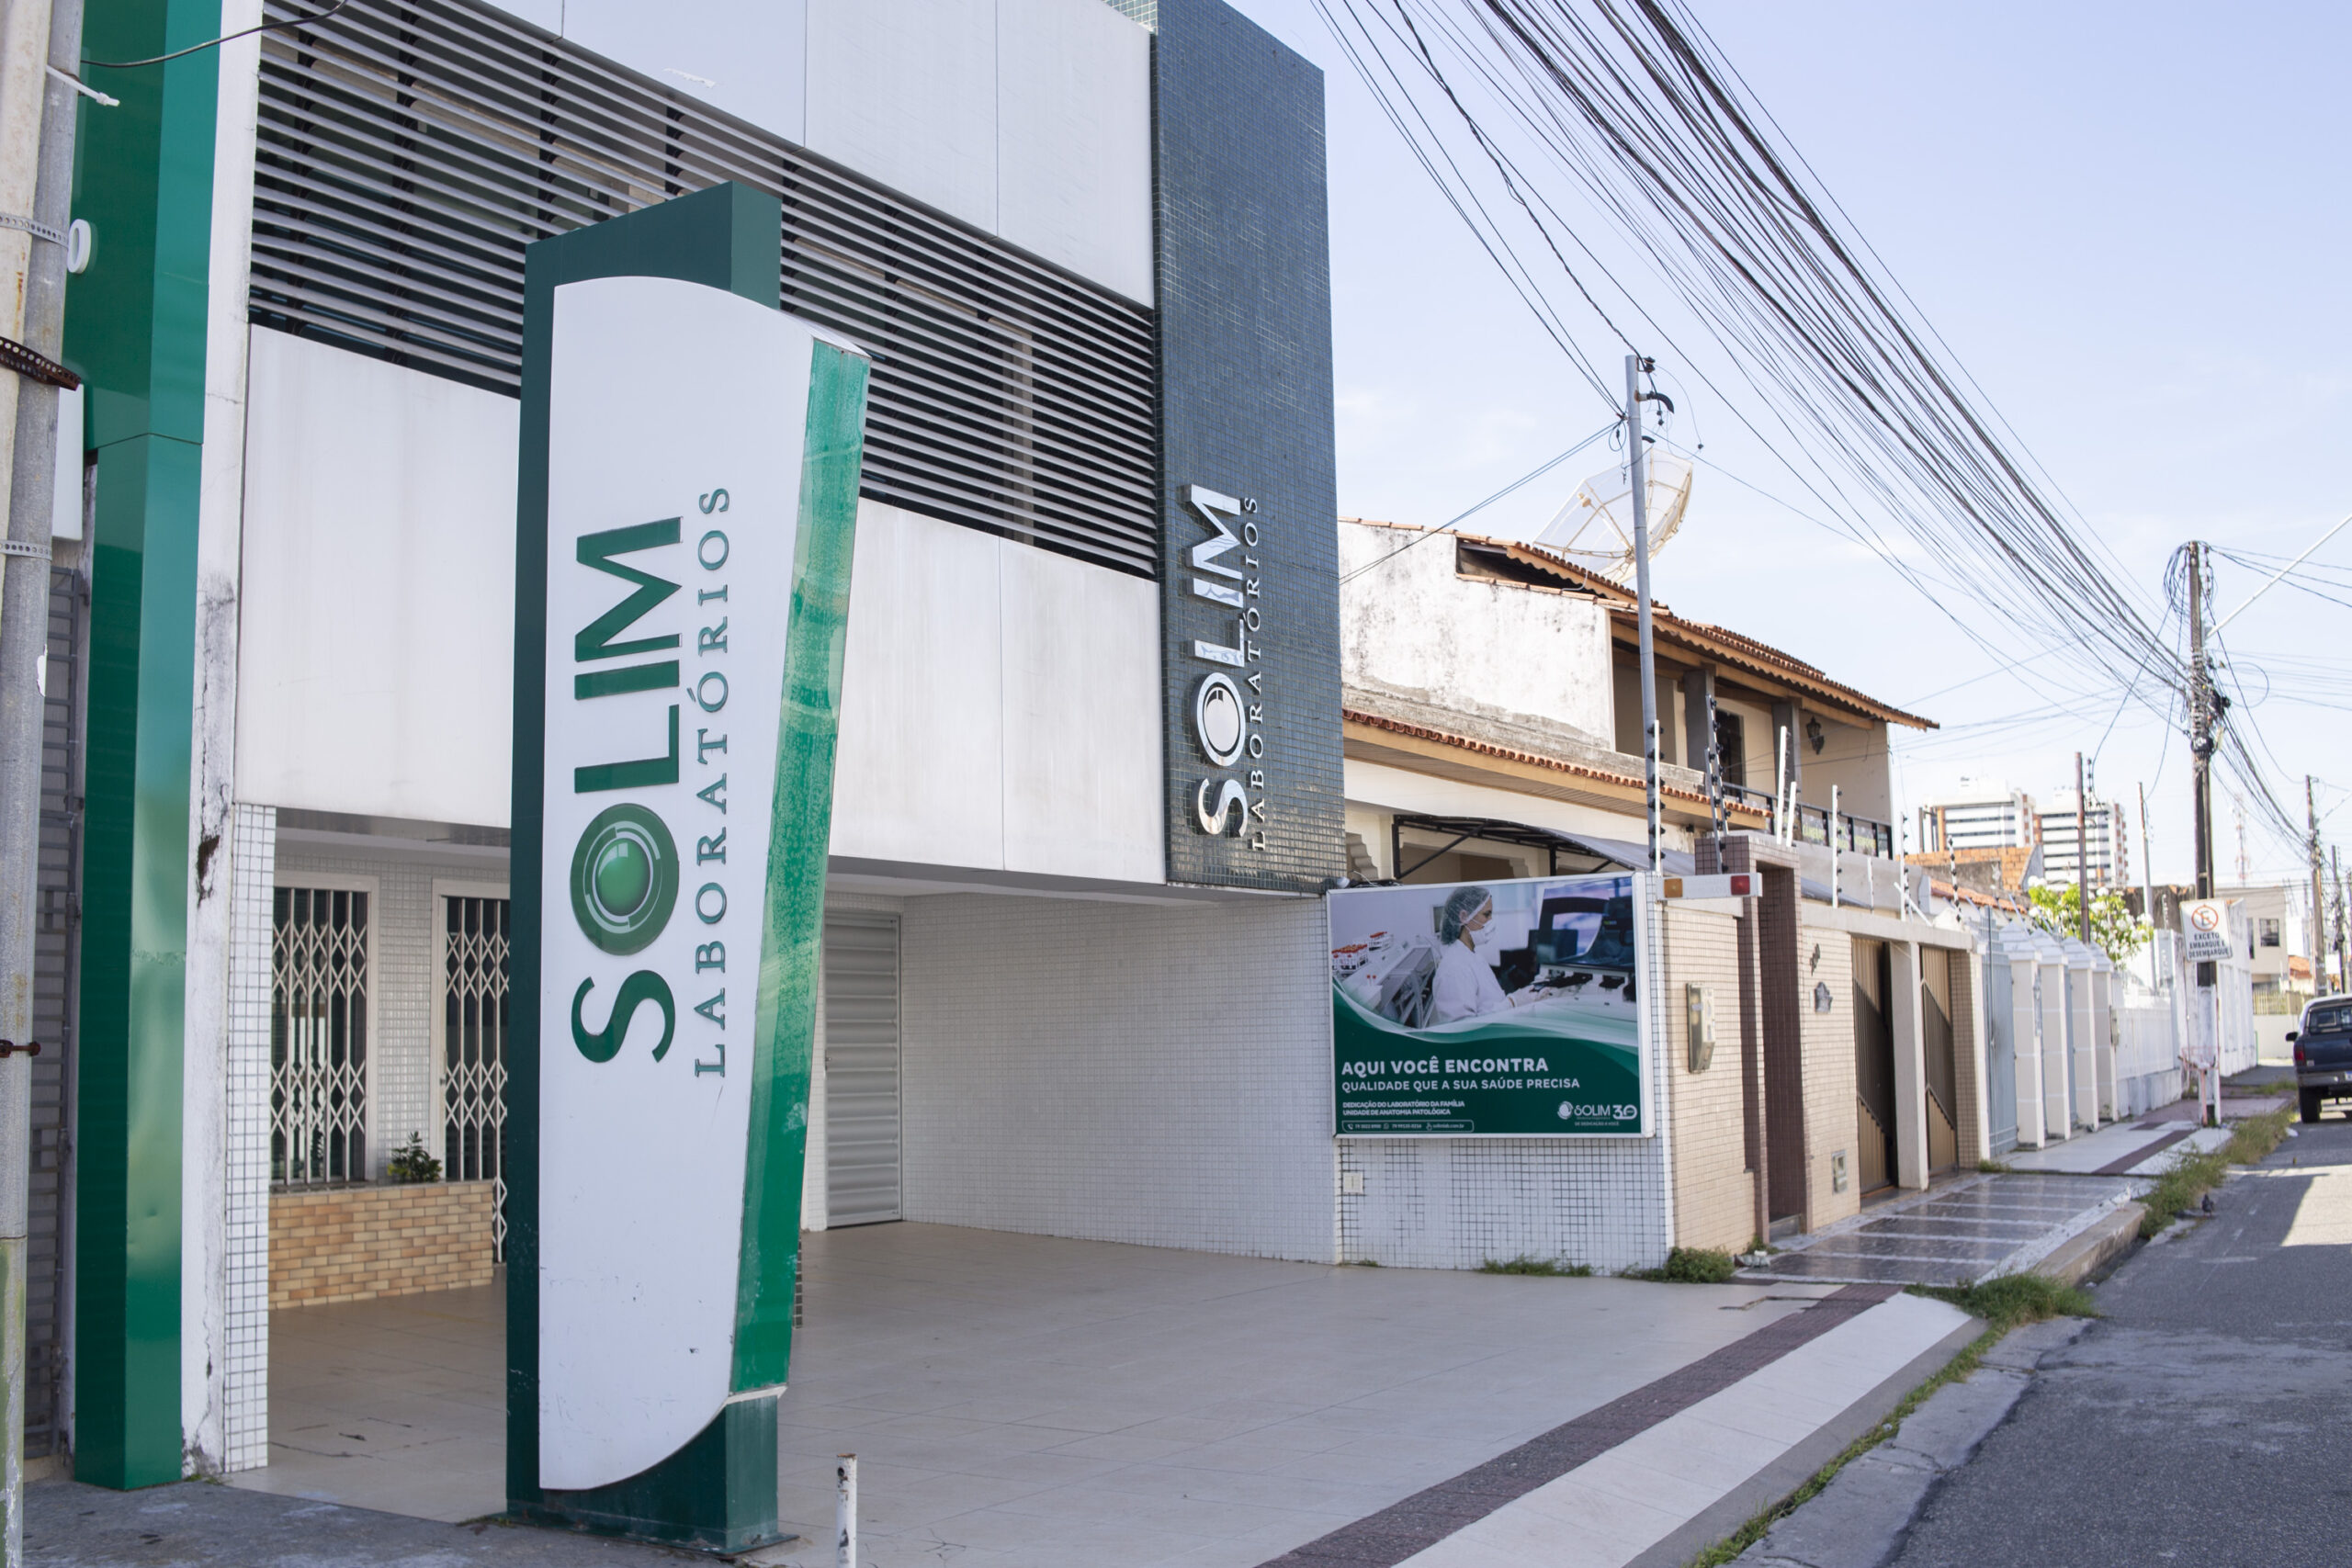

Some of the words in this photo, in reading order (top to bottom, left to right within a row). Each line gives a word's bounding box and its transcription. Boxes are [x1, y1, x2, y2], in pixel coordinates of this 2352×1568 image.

[1191, 483, 1249, 837] SOLIM
[1242, 496, 1266, 852] LABORATÓRIOS
[571, 515, 683, 1063] SOLIM
[687, 487, 731, 1077] LABORATÓRIOS
[2194, 931, 2220, 942] EXCETO
[2188, 947, 2229, 958] DESEMBARQUE
[2189, 940, 2220, 950] EMBARQUE
[1341, 1060, 1385, 1078] AQUI
[1390, 1055, 1440, 1075] VOCÊ
[1444, 1057, 1549, 1074] ENCONTRA
[1341, 1080, 1410, 1094] QUALIDADE
[1413, 1079, 1439, 1092] QUE
[1442, 1079, 1451, 1090] A
[1453, 1079, 1478, 1090] SUA
[1481, 1076, 1523, 1090] SAÚDE
[1526, 1077, 1580, 1089] PRECISA
[1342, 1100, 1377, 1109] DEDICAÇÃO
[1387, 1100, 1430, 1108] LABORATÓRIO
[1440, 1099, 1465, 1108] FAMÍLIA
[1379, 1108, 1412, 1116] ANATOMIA
[1412, 1107, 1452, 1116] PATOLÓGICA
[1574, 1104, 1611, 1116] SOLIM
